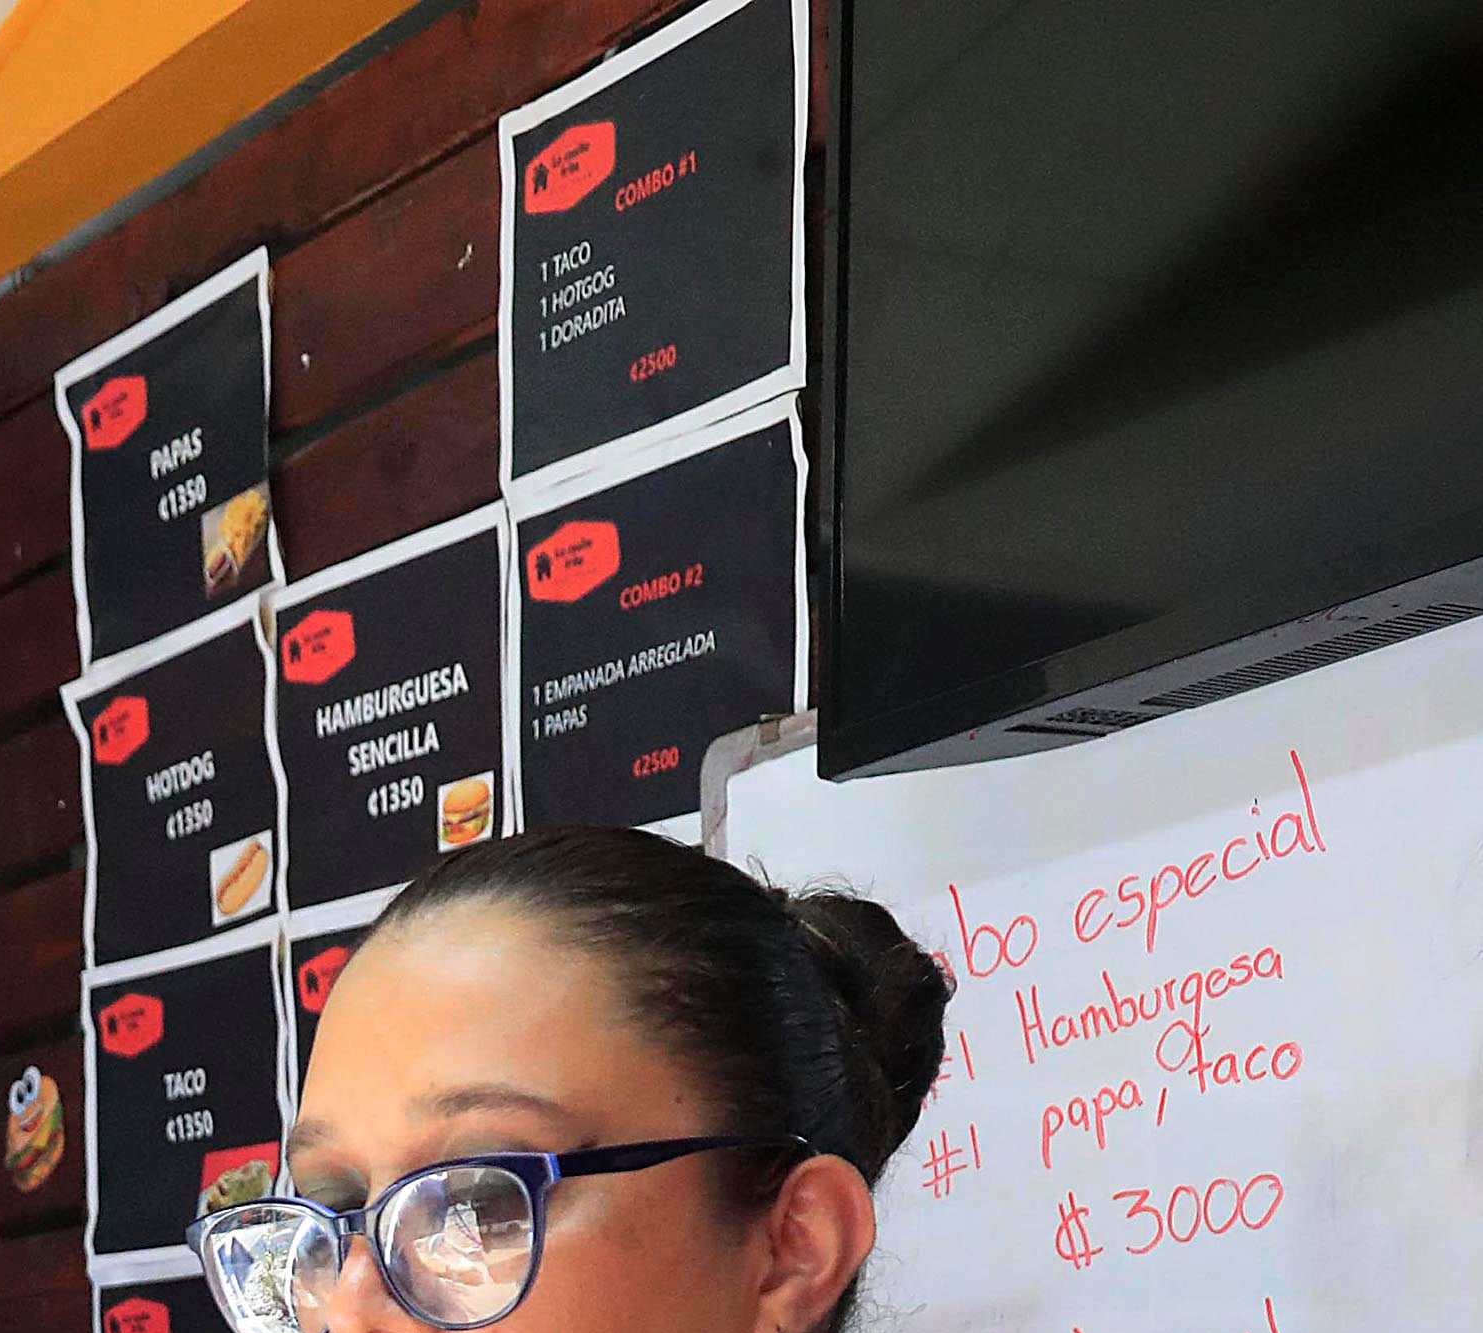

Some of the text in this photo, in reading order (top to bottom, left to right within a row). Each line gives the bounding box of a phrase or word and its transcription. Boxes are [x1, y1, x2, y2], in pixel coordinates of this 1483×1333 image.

[615, 150, 697, 212] COMBO #1
[540, 241, 592, 282] 1 TACO
[540, 264, 615, 318] 1 HOTGOG
[539, 296, 626, 352] 1 DORADITA
[149, 427, 203, 480] PAPAS
[619, 563, 704, 610] COMBO #2
[532, 630, 716, 707] 1 EMPANADA ARREGLADA
[316, 662, 470, 738] HAMBURGUESA
[532, 704, 588, 741] 1 PAPAS
[145, 750, 215, 804] HOTDOG
[347, 722, 440, 777] SENCILLA
[1074, 749, 1326, 954] especial
[1015, 946, 1284, 1072] Hamburgesa
[163, 1067, 207, 1099] TACO
[922, 1123, 981, 1199] #1
[1188, 1033, 1304, 1094] taco
[1113, 1173, 1284, 1255] 3000
